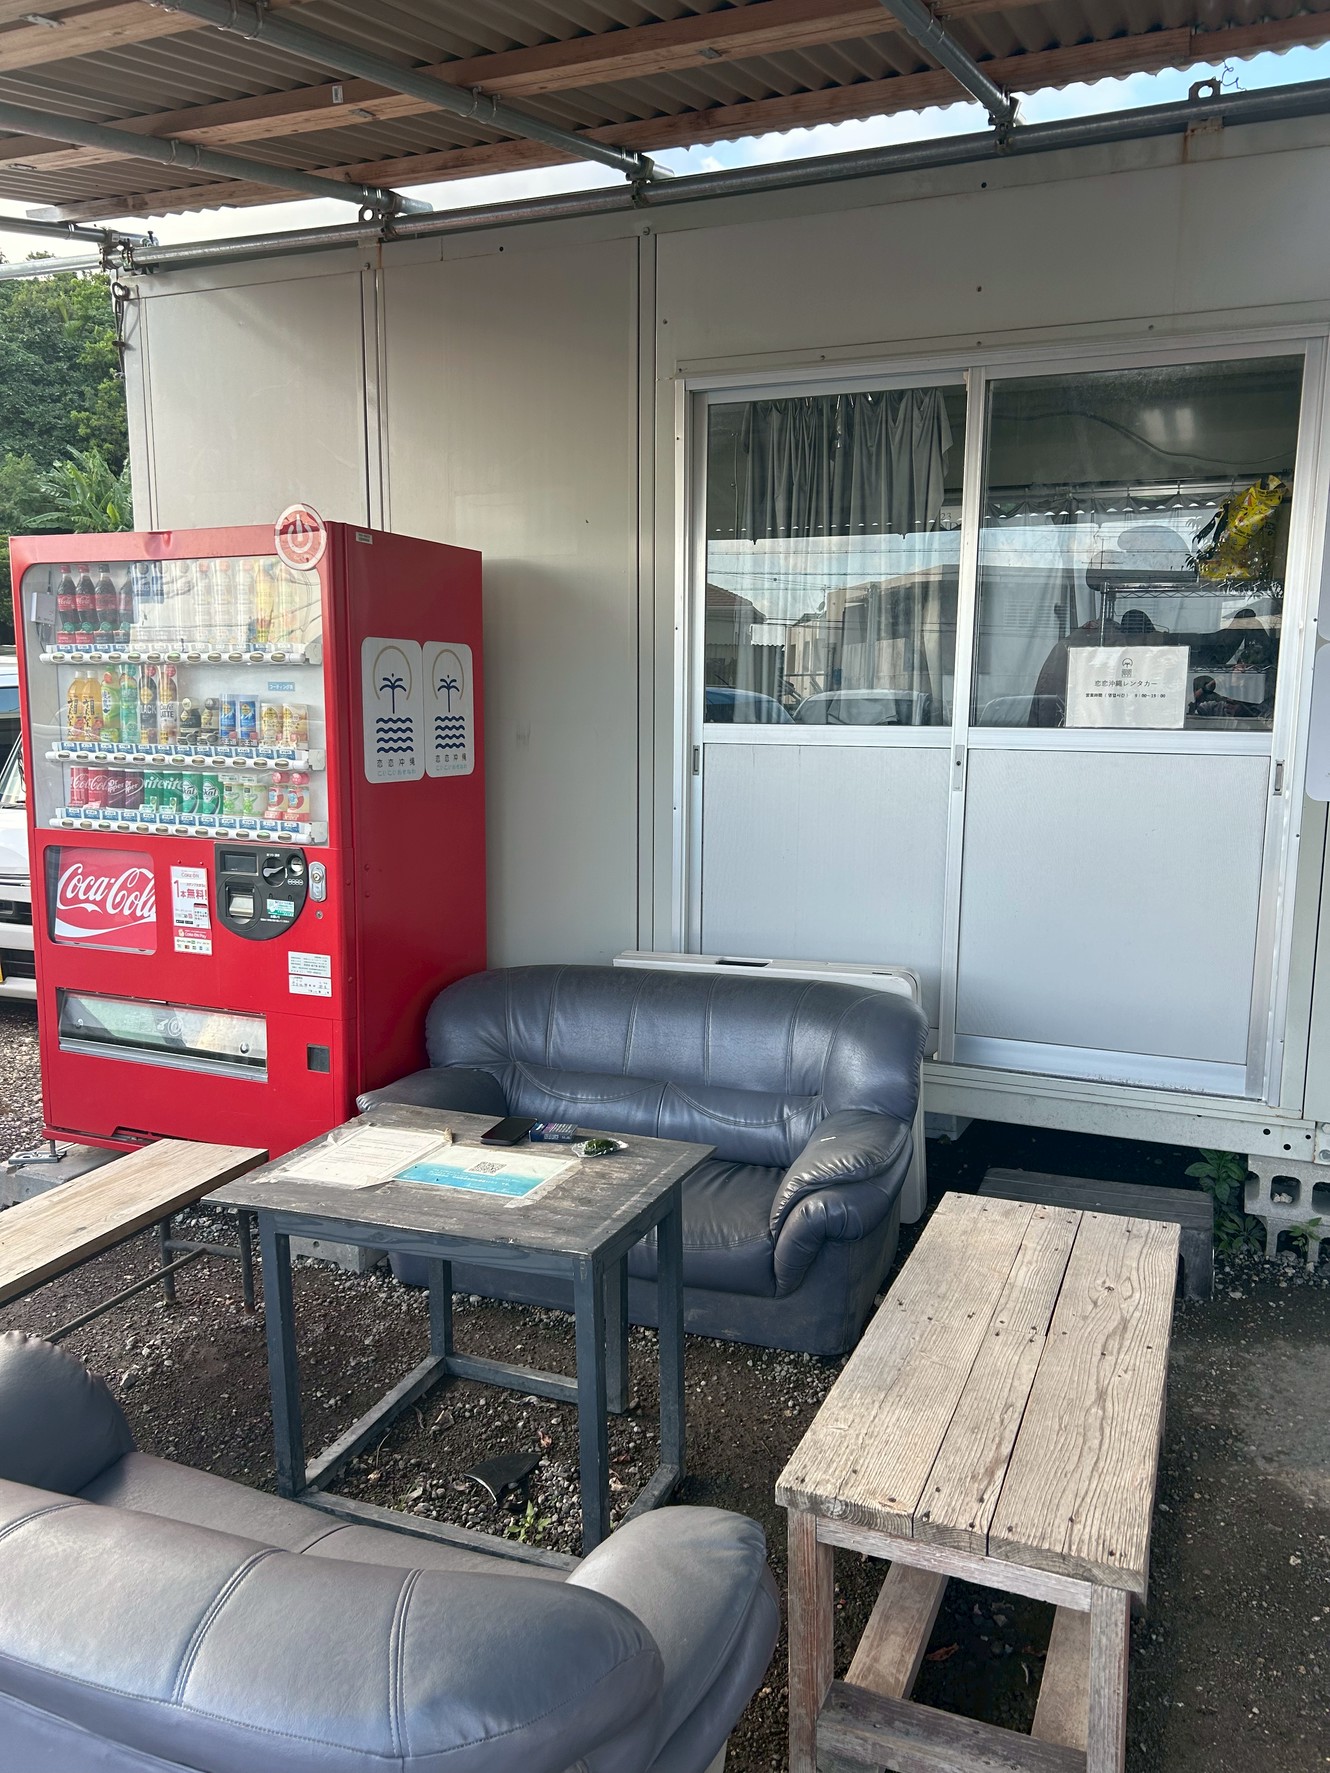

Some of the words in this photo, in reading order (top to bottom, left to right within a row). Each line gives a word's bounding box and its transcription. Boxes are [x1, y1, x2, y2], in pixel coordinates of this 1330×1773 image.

[376, 757, 416, 768] 恋恋沖縄
[56, 863, 156, 918] Coca-Cola
